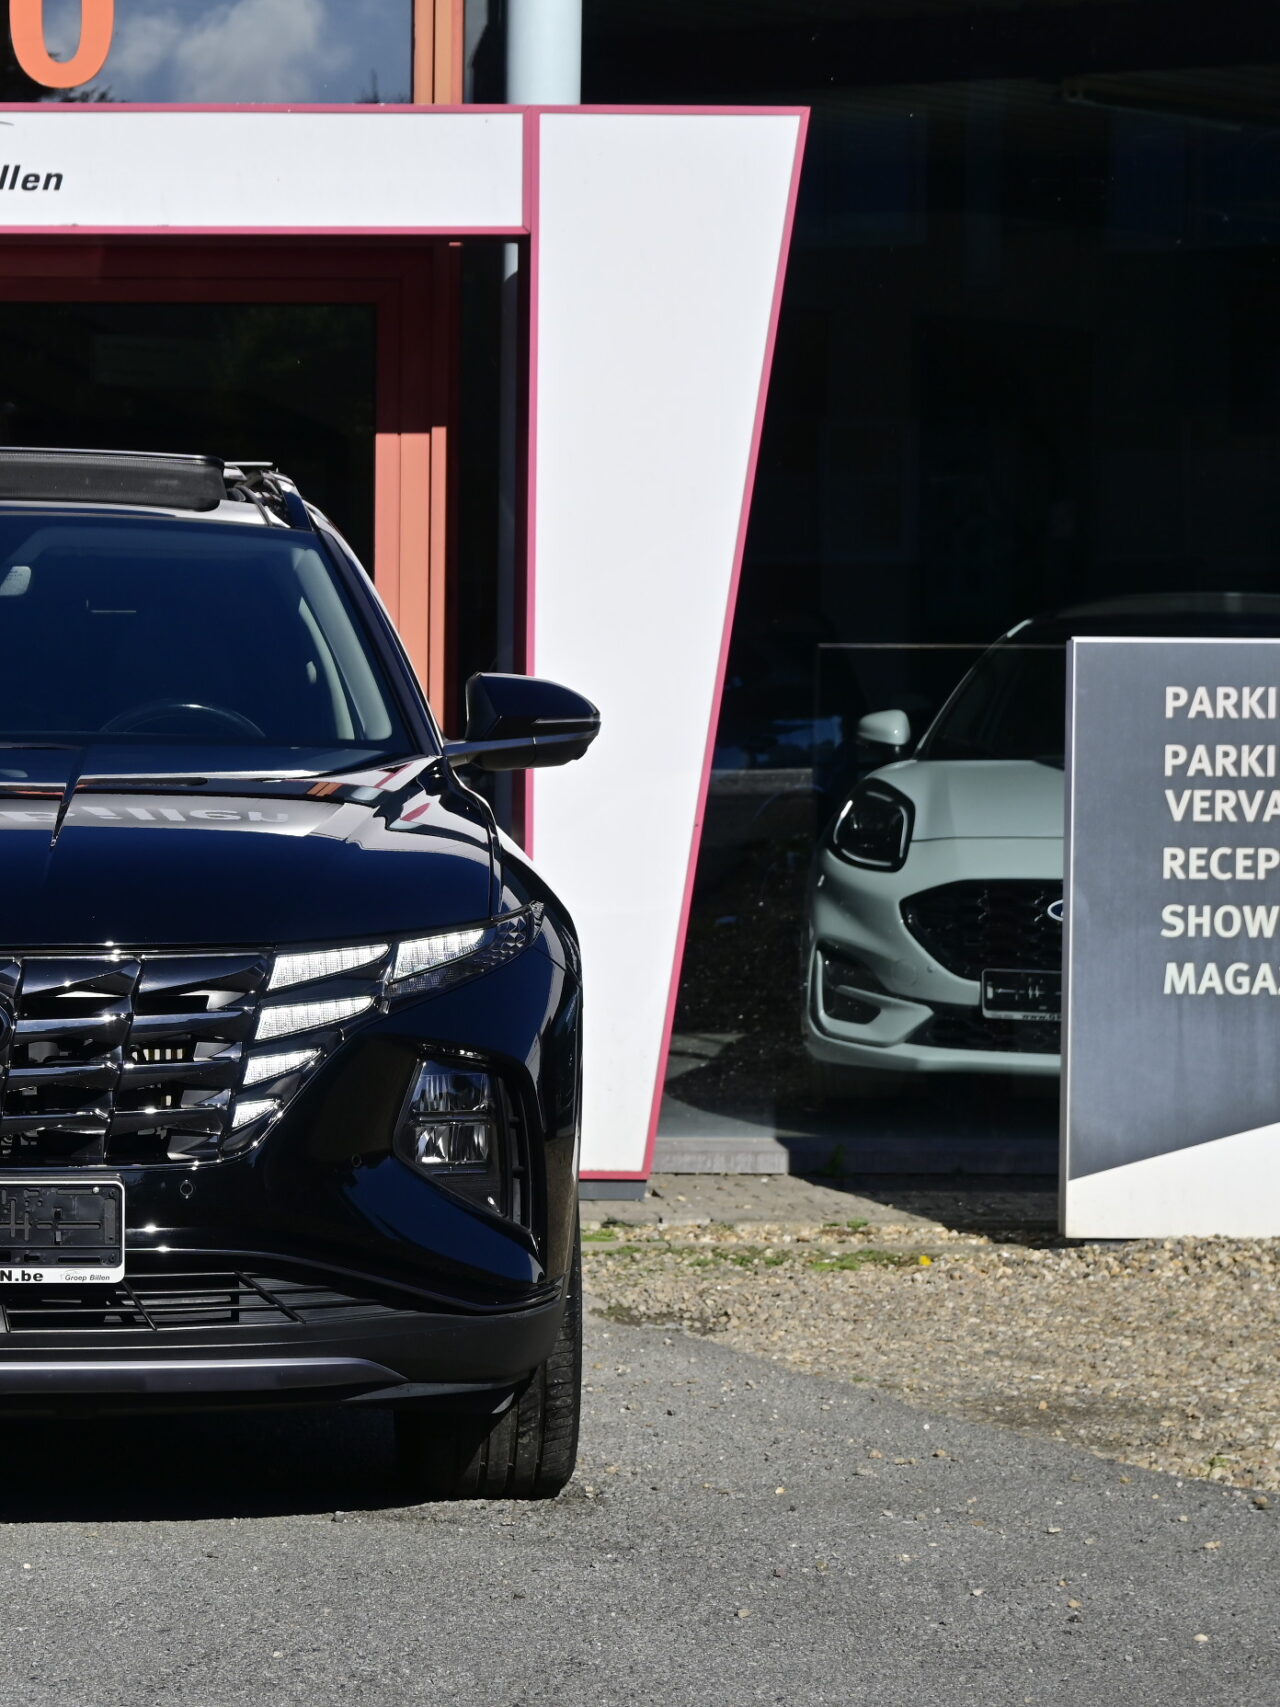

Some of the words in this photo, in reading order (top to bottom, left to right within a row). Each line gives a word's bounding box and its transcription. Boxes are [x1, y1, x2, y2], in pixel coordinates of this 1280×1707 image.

[1165, 686, 1277, 719] PARKI
[1164, 744, 1276, 777] PARKI
[1165, 789, 1280, 822] VERVA
[1163, 847, 1280, 880] RECEP
[1160, 904, 1280, 938] SHOW
[1163, 962, 1280, 995] MAGA
[64, 1274, 88, 1282] Groep
